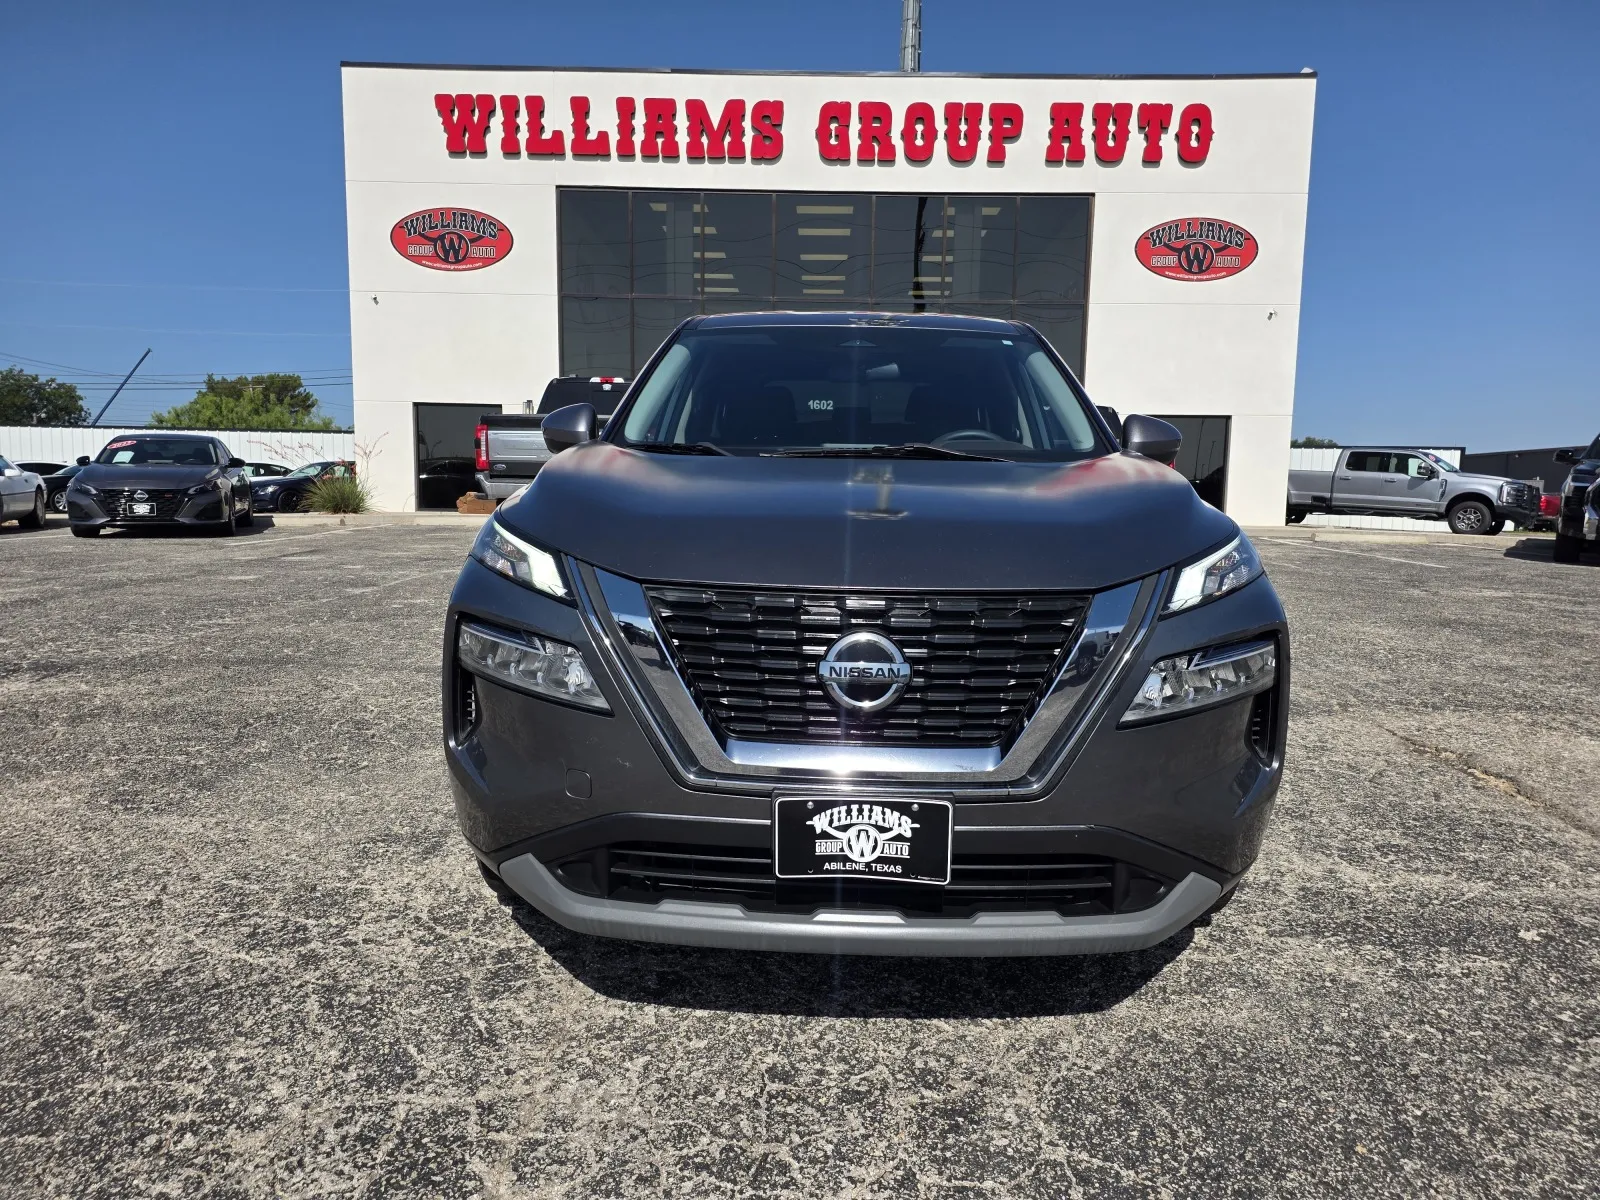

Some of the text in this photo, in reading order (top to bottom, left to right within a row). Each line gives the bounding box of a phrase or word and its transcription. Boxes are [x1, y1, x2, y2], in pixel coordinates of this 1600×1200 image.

[435, 93, 1214, 166] WILLIAMS GROUP AUTO
[403, 211, 499, 240] WILLIAMS
[1149, 221, 1245, 250] WILLIAMS
[407, 232, 496, 262] GROUP W AUTO
[1151, 243, 1241, 273] GROUP W AUTO
[808, 399, 834, 410] 1602
[829, 665, 901, 679] NISSAN
[812, 804, 912, 839] WILLIAMS
[815, 829, 910, 858] GROUP W AUTO
[823, 861, 903, 874] ABILENE, TEXAS
